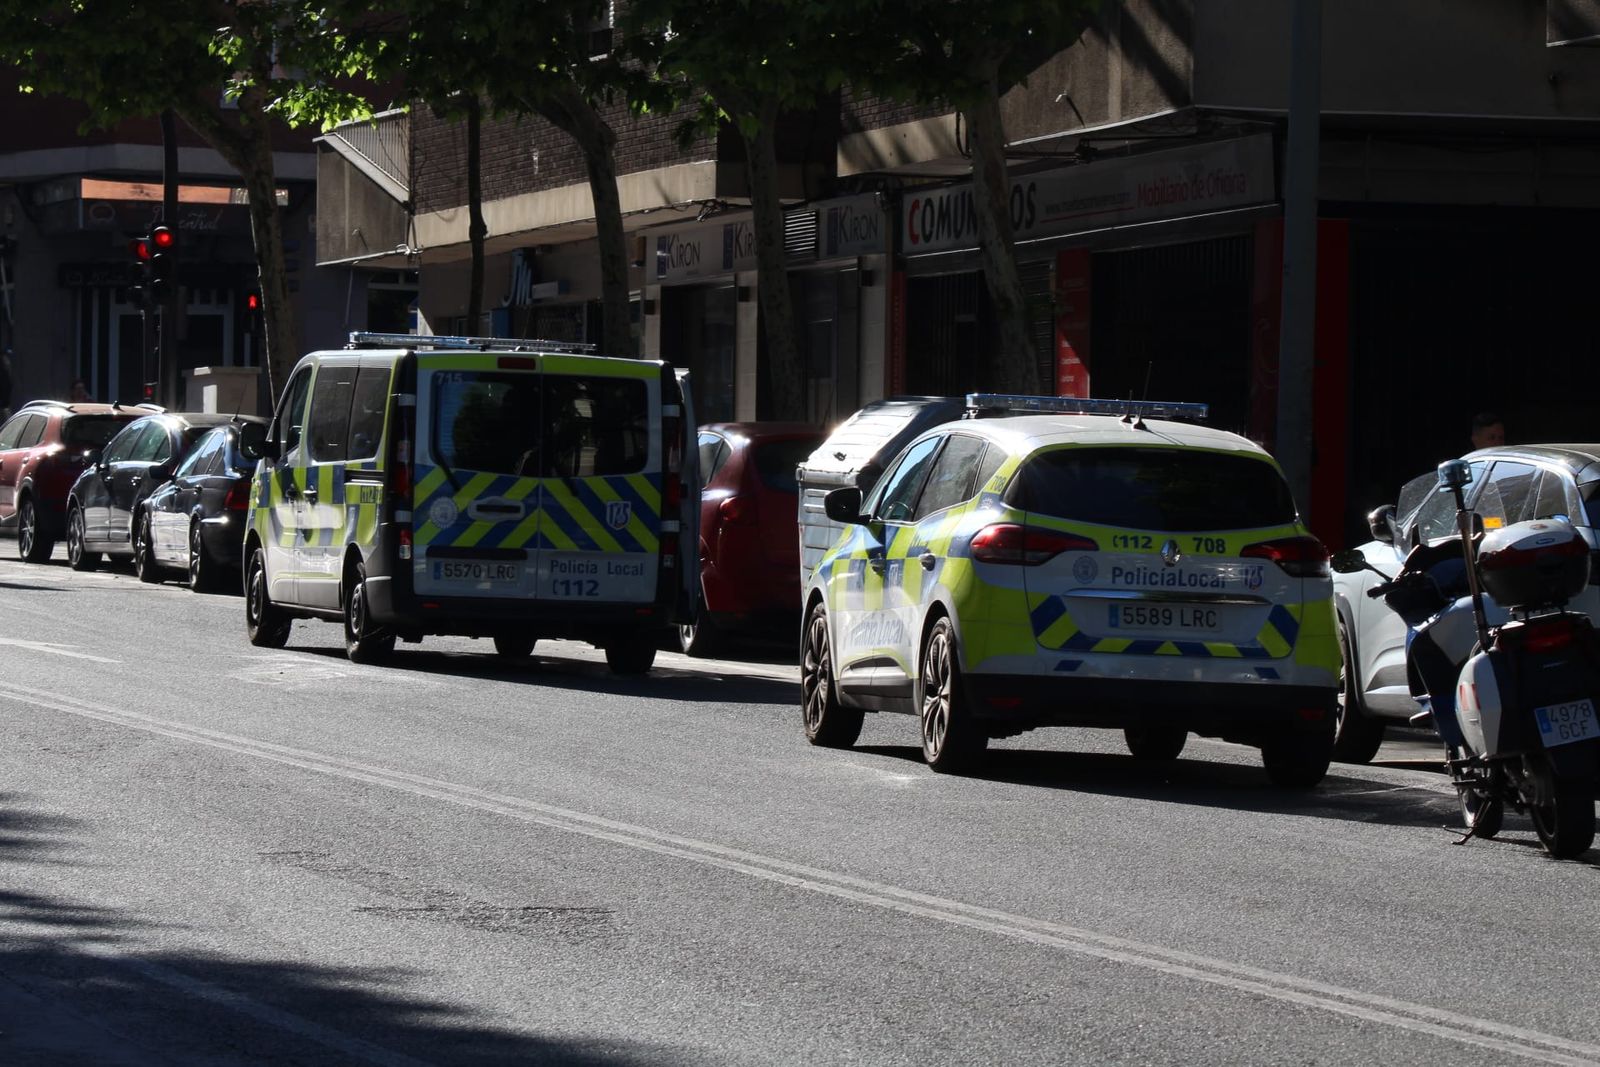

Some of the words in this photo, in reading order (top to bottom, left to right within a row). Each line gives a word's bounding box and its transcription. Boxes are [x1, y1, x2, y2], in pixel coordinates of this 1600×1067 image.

[1192, 174, 1204, 201] de
[1207, 167, 1247, 197] Oficina
[909, 182, 1036, 245] COMUNOS
[436, 372, 464, 385] 715
[1193, 537, 1226, 554] 708
[444, 564, 482, 578] 5570
[487, 565, 515, 579] LRC
[551, 559, 598, 574] Policía
[607, 561, 644, 576] Local
[1123, 606, 1172, 625] 5589
[1181, 609, 1217, 628] LRC
[1551, 702, 1591, 722] 4978
[1559, 720, 1588, 740] GCF
